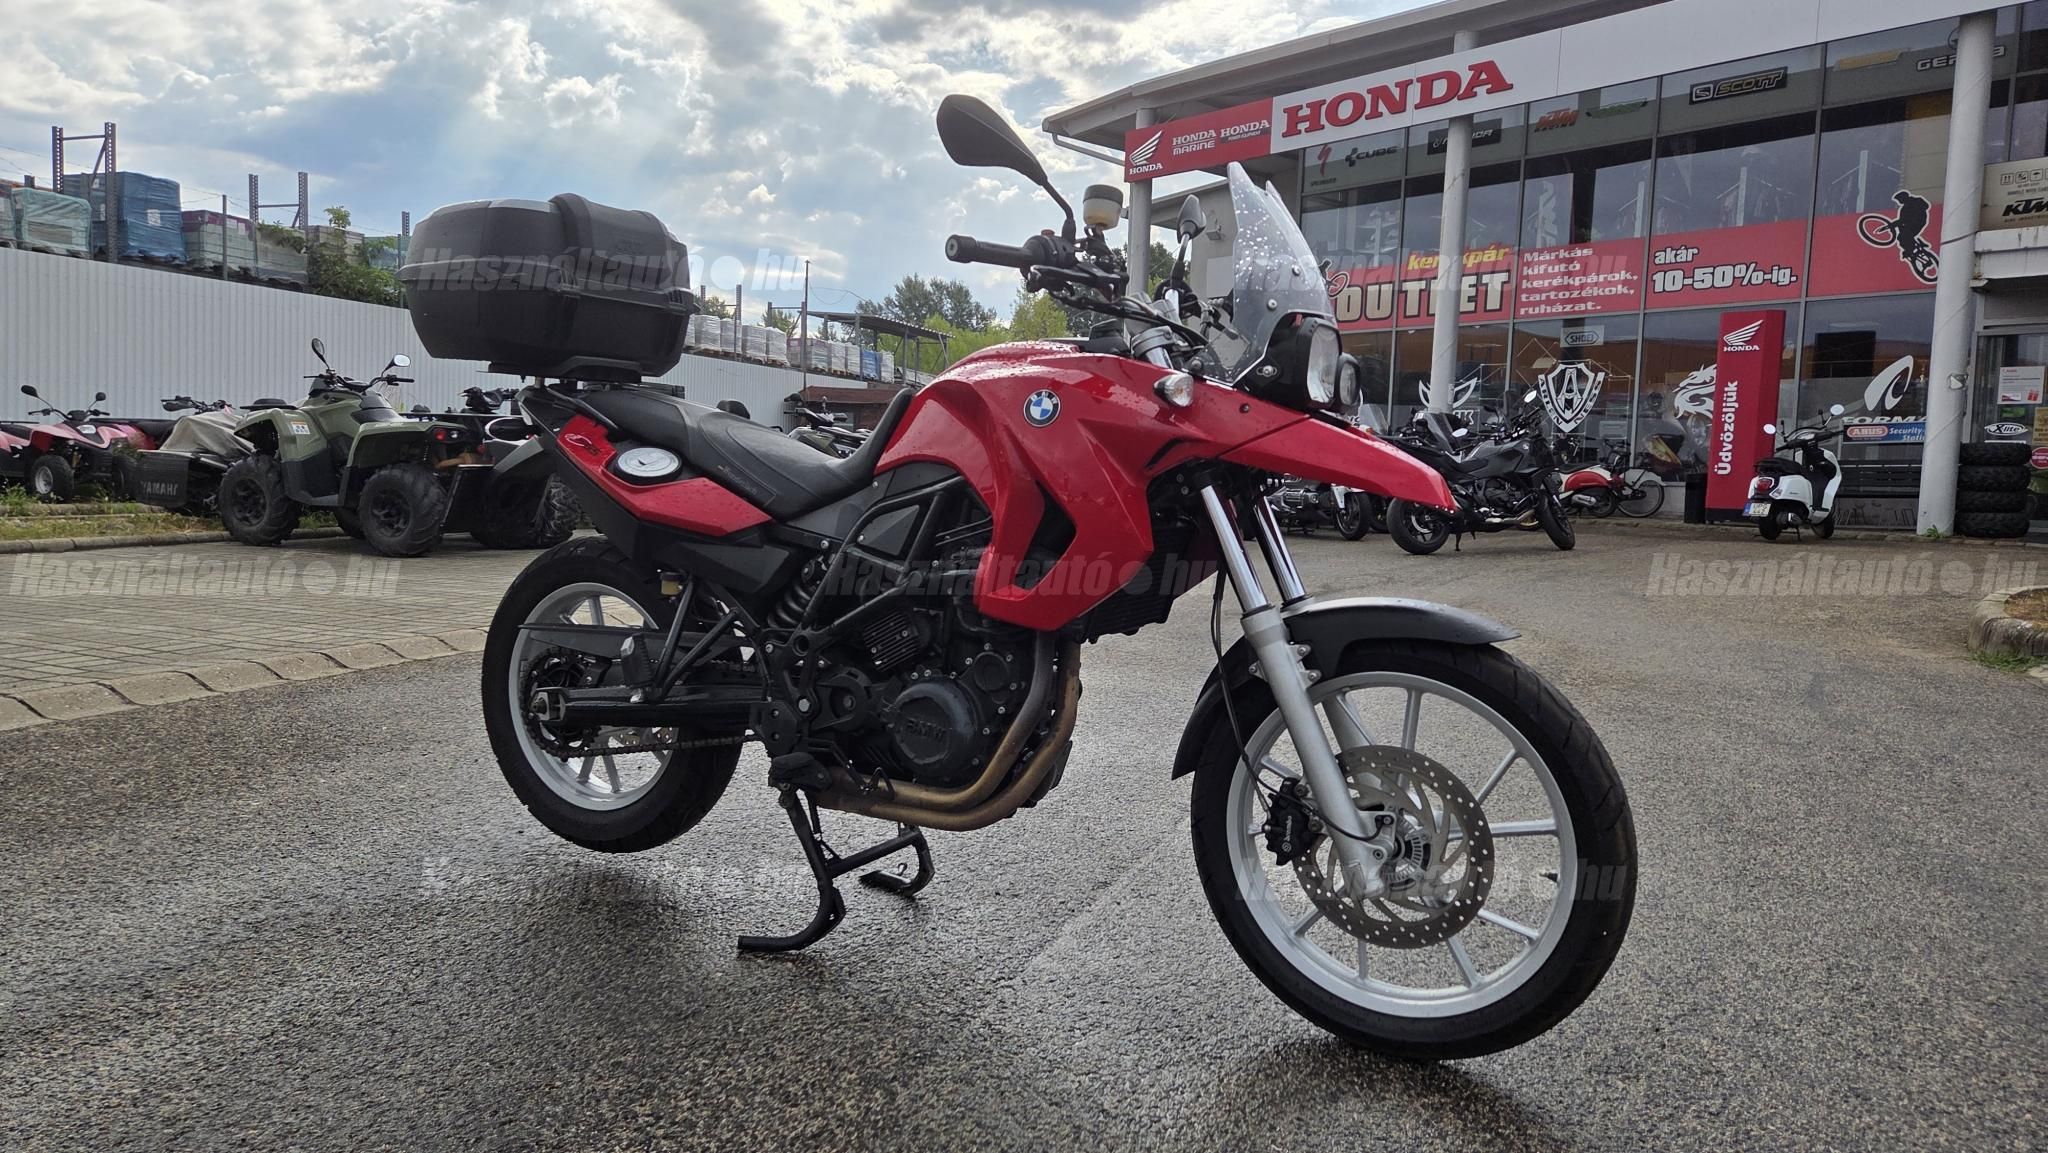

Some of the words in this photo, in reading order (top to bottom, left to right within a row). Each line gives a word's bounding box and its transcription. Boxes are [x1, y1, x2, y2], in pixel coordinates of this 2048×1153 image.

[1716, 72, 1783, 95] SCOTT
[1282, 60, 1514, 138] HONDA
[1220, 119, 1271, 138] HONDA
[1172, 130, 1216, 146] HONDA
[1173, 140, 1216, 156] MARINE
[1356, 146, 1398, 160] CUBE
[1129, 162, 1163, 175] HONDA
[1407, 245, 1511, 271] kerpár
[1523, 247, 1593, 263] Márkás
[1654, 245, 1699, 265] akár
[1522, 260, 1580, 276] kifutó
[1521, 270, 1639, 289] kerékpárok,
[1652, 262, 1798, 293] 10-50%-ig.
[1520, 284, 1635, 302] tartozékok,
[1520, 301, 1602, 315] ruházat.
[1030, 391, 1058, 405] BMW
[1714, 380, 1739, 475] Üdvözöljük
[1852, 428, 1883, 436] ABUS
